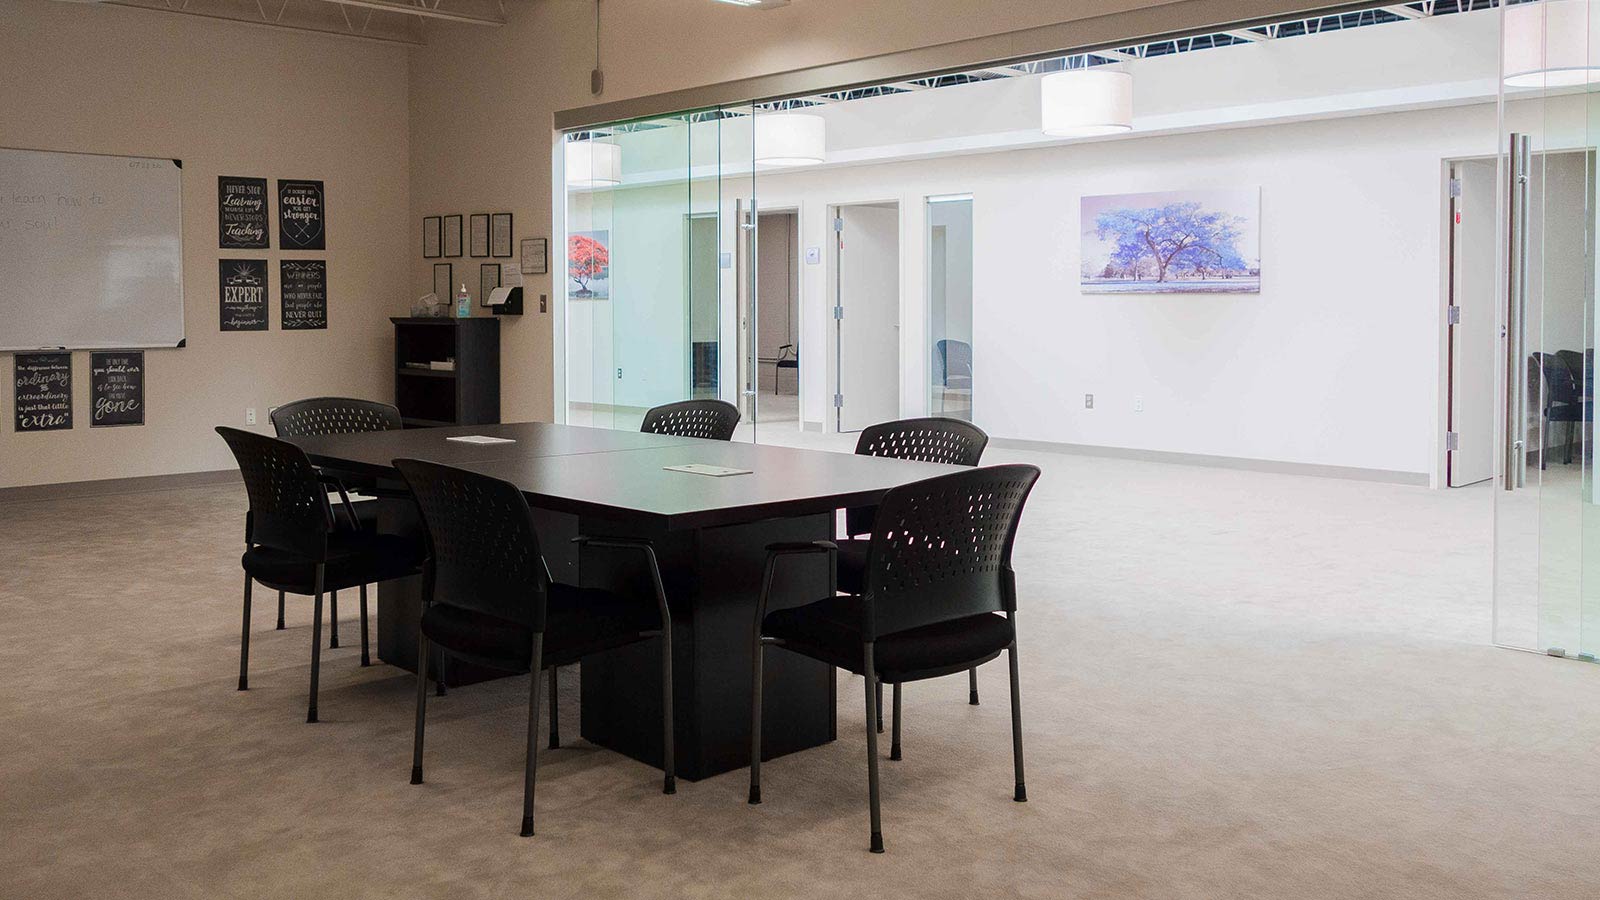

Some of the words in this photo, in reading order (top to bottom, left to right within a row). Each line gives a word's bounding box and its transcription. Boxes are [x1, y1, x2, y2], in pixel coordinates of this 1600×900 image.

[226, 185, 246, 194] NEVER
[223, 194, 262, 210] Learning
[224, 223, 264, 240] Teaching
[224, 286, 264, 303] EXPERT
[17, 371, 70, 387] ordinary
[17, 391, 68, 402] extraordinary
[95, 397, 140, 420] gone
